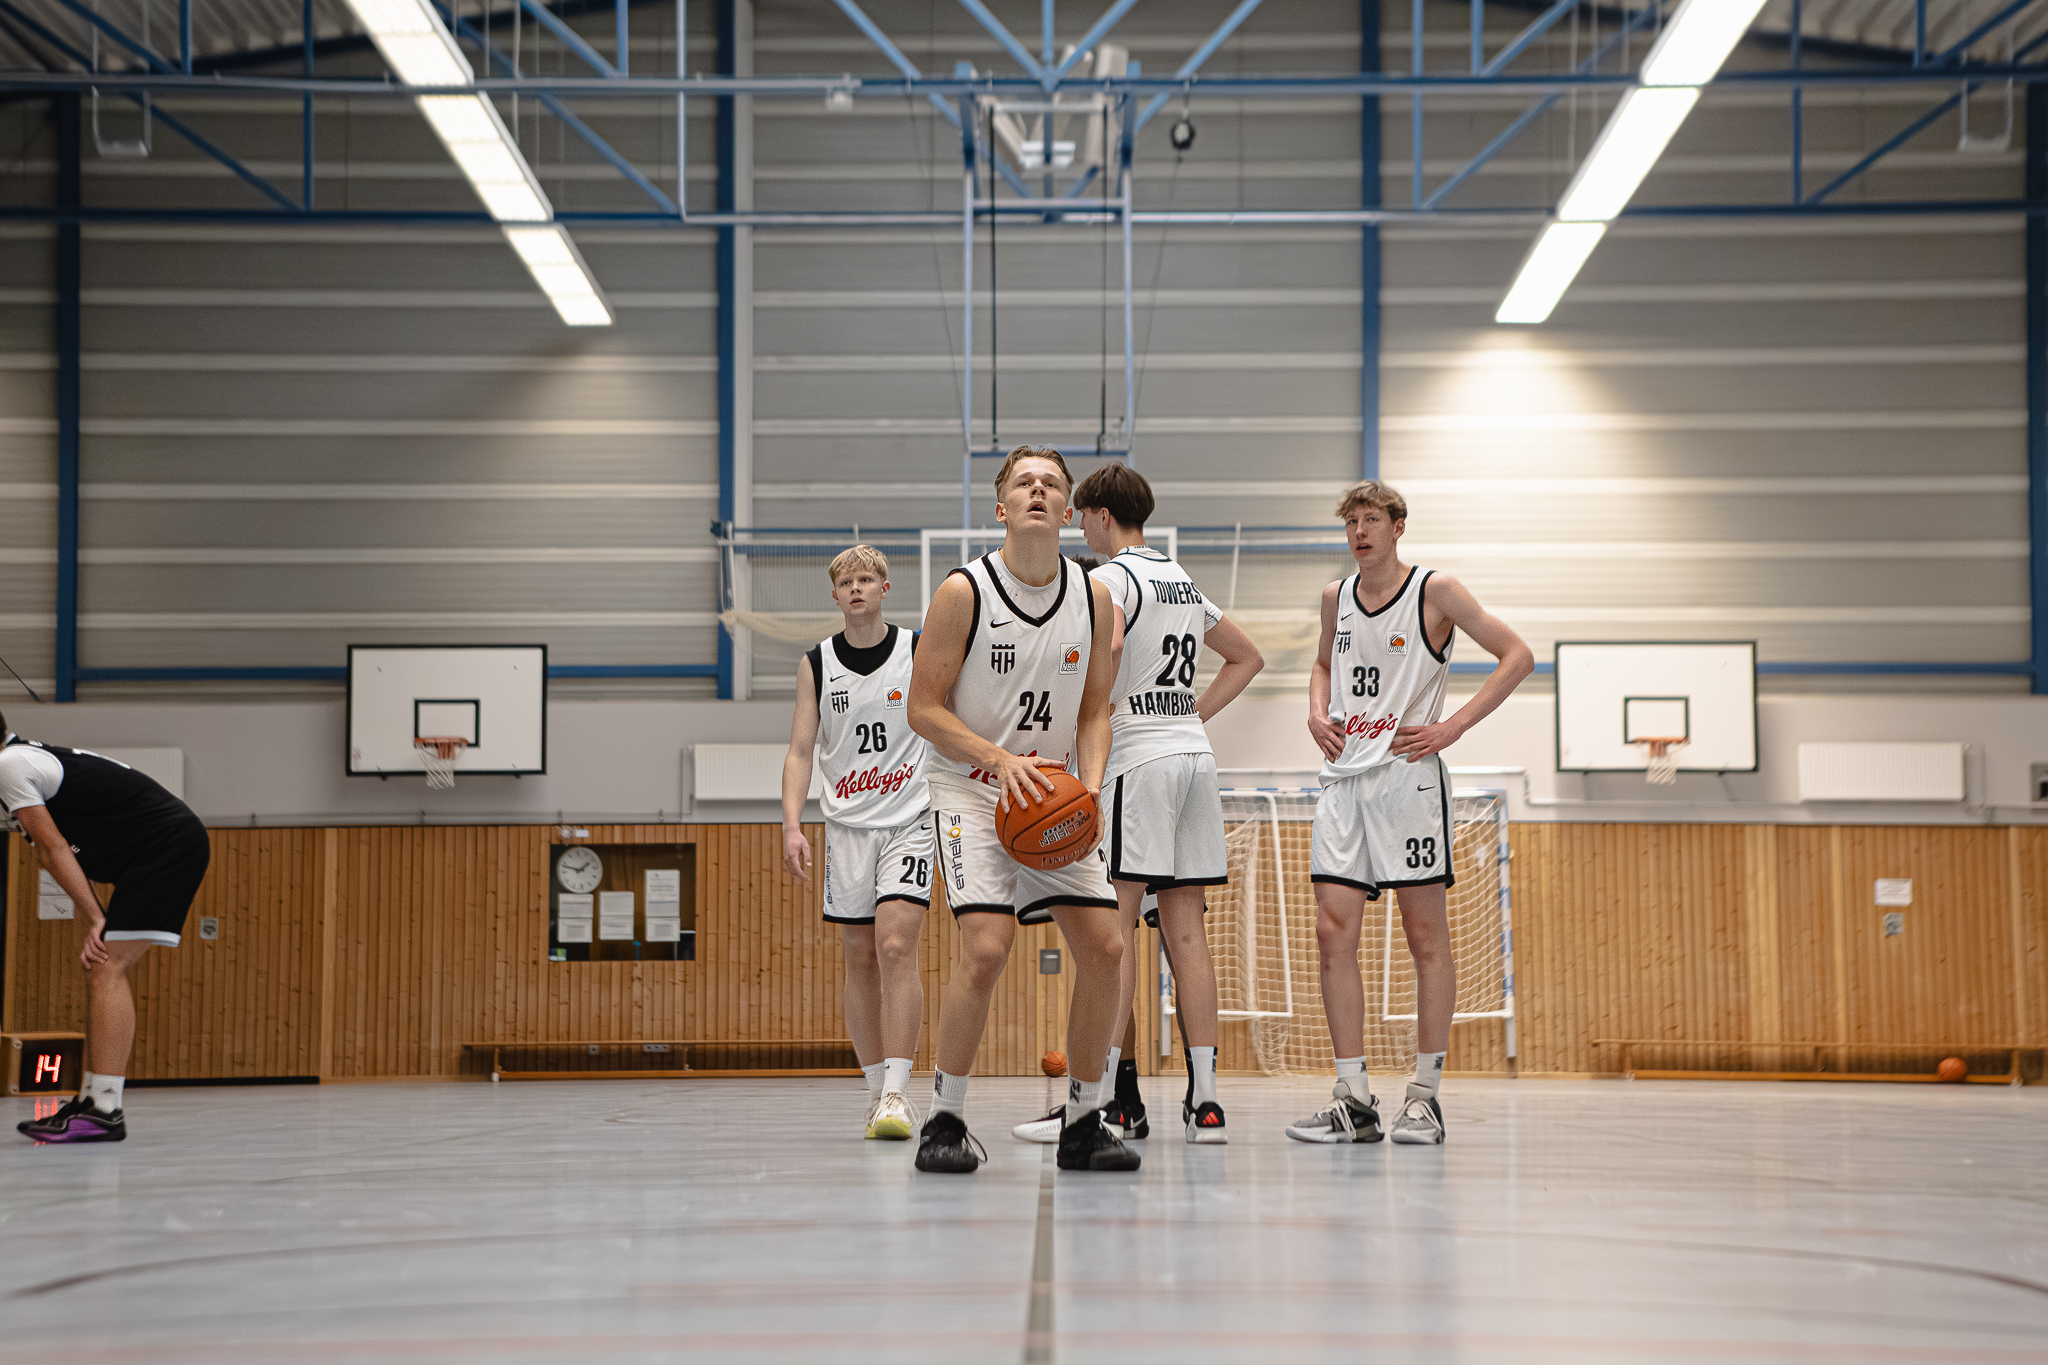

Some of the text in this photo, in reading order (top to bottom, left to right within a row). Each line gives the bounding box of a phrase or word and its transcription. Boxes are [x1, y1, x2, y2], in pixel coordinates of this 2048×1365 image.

[1148, 579, 1203, 605] TOWERS
[1155, 633, 1197, 688] 28
[1352, 665, 1380, 698] 33
[1016, 690, 1053, 732] 24
[1128, 691, 1198, 716] HAMBUR
[855, 721, 888, 755] 26
[835, 763, 916, 799] Kellogg's
[1405, 836, 1436, 869] 33
[899, 855, 928, 888] 26
[35, 1054, 62, 1084] 14
